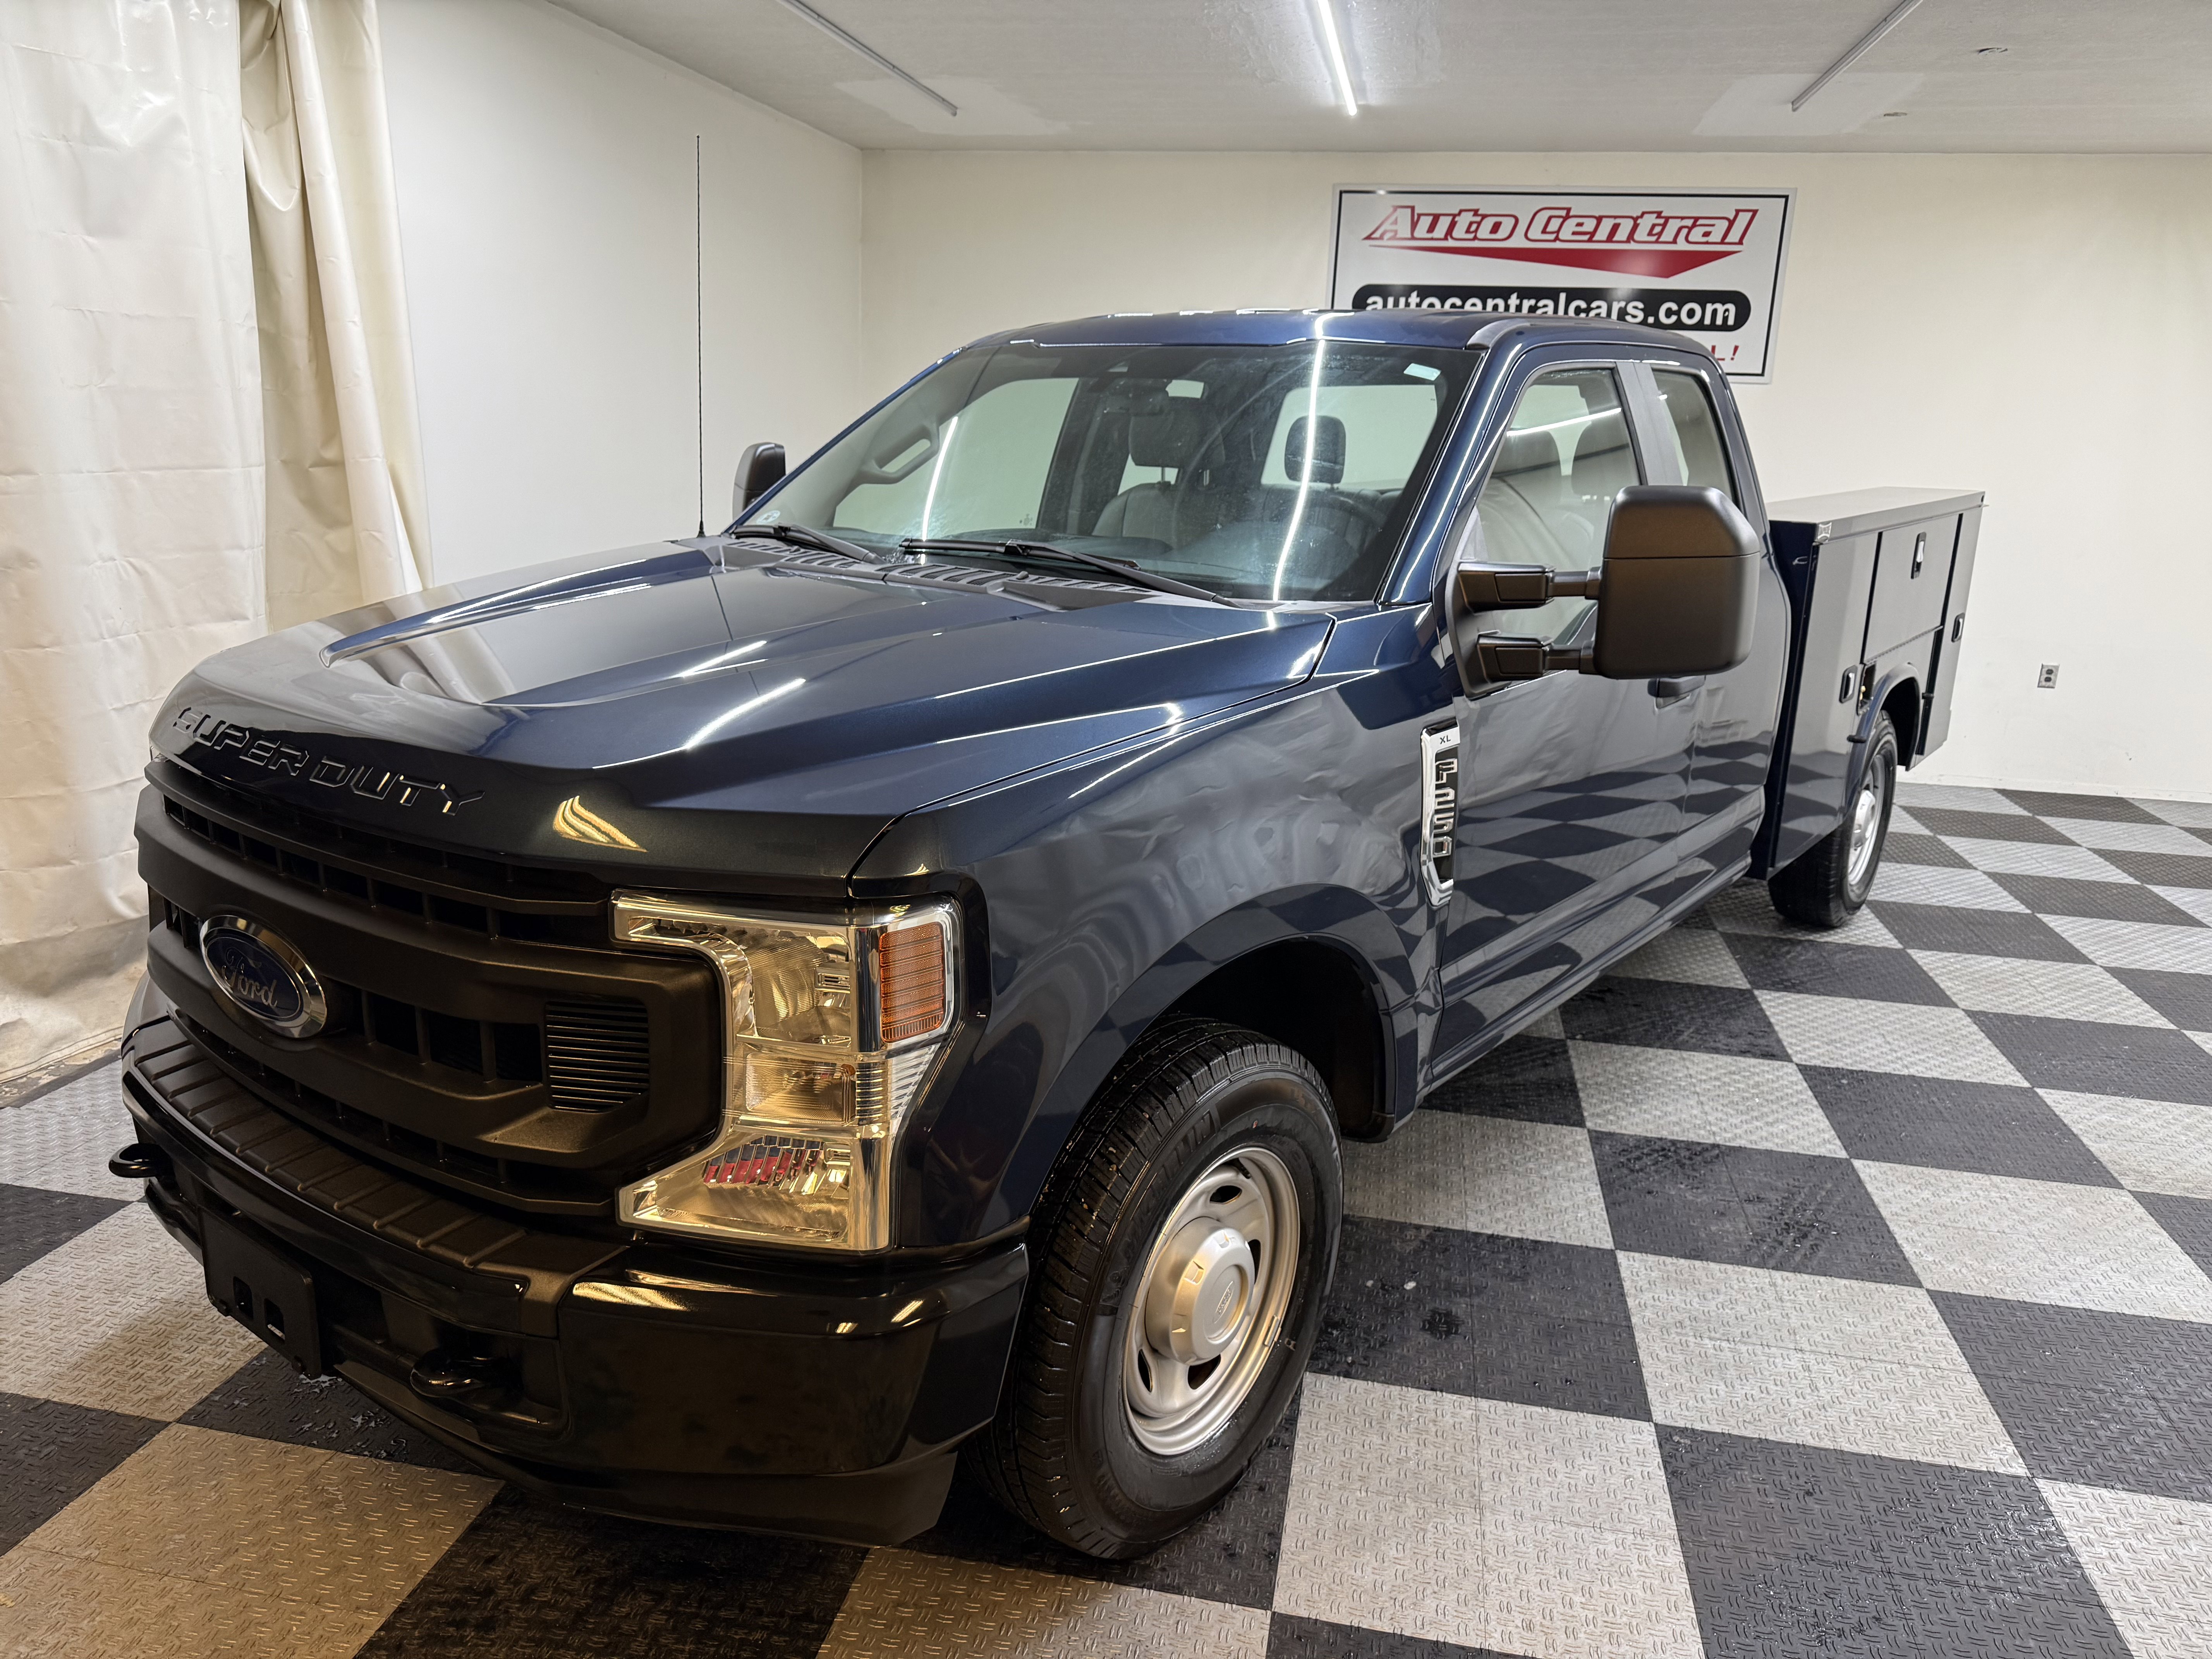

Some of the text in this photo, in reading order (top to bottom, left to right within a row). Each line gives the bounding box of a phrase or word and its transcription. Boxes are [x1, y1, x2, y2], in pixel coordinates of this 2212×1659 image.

[1362, 205, 1759, 245] Auto Central
[173, 707, 485, 816] SUPER DUTY
[1439, 735, 1451, 745] XL
[222, 946, 279, 1009] Ford
